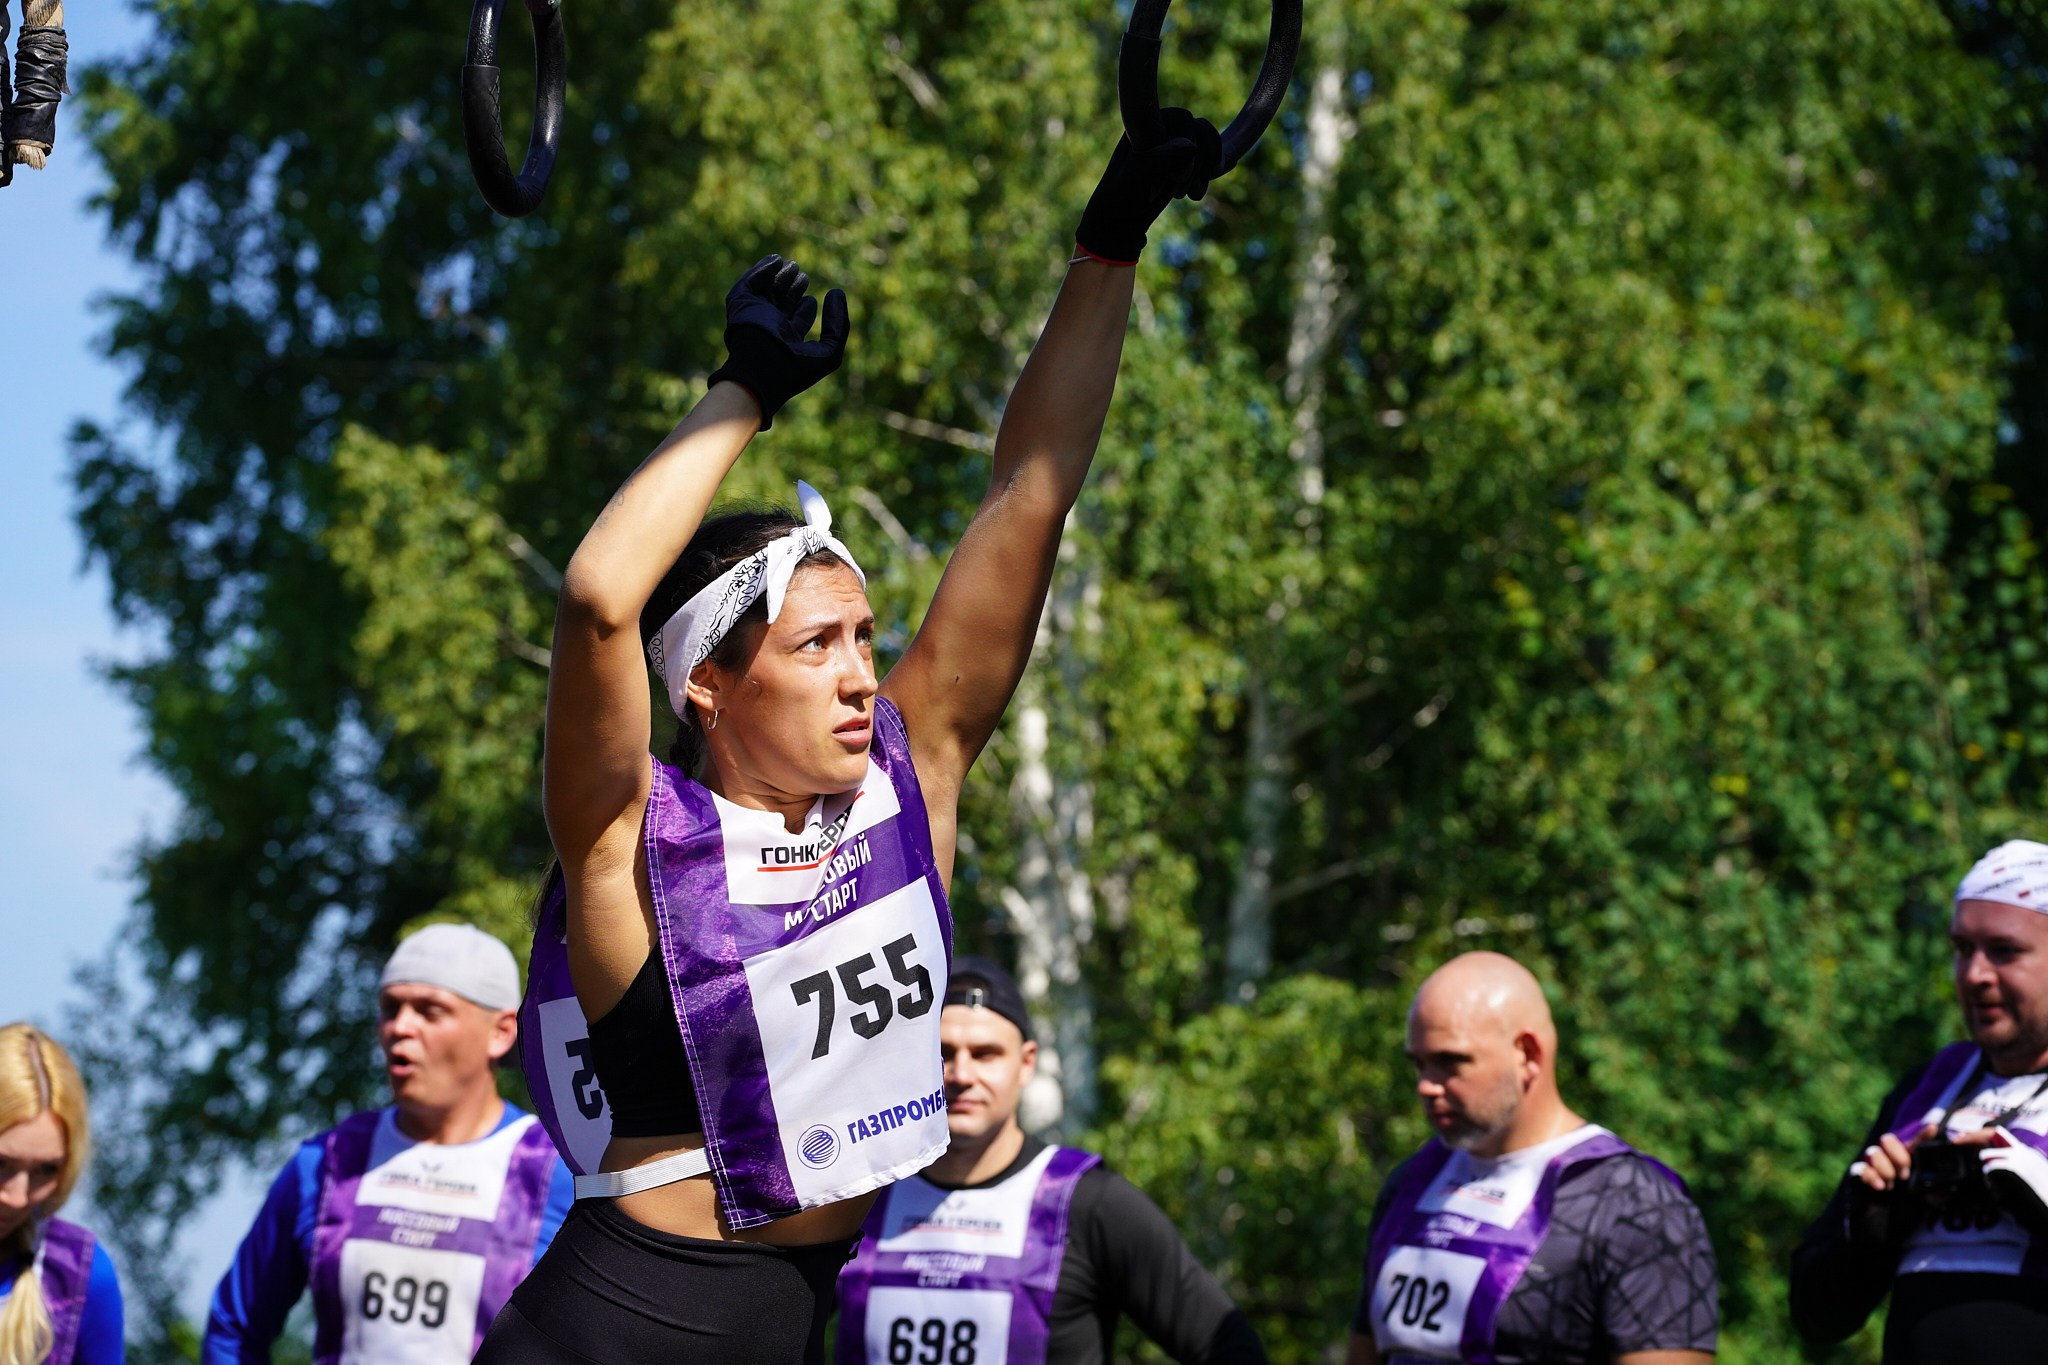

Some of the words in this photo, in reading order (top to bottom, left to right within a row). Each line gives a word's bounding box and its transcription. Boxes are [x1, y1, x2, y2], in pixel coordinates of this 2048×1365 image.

[810, 877, 858, 922] СТАРТ
[790, 932, 935, 1061] 755
[362, 1270, 450, 1329] 699
[1382, 1273, 1451, 1332] 702
[888, 1316, 978, 1365] 698
